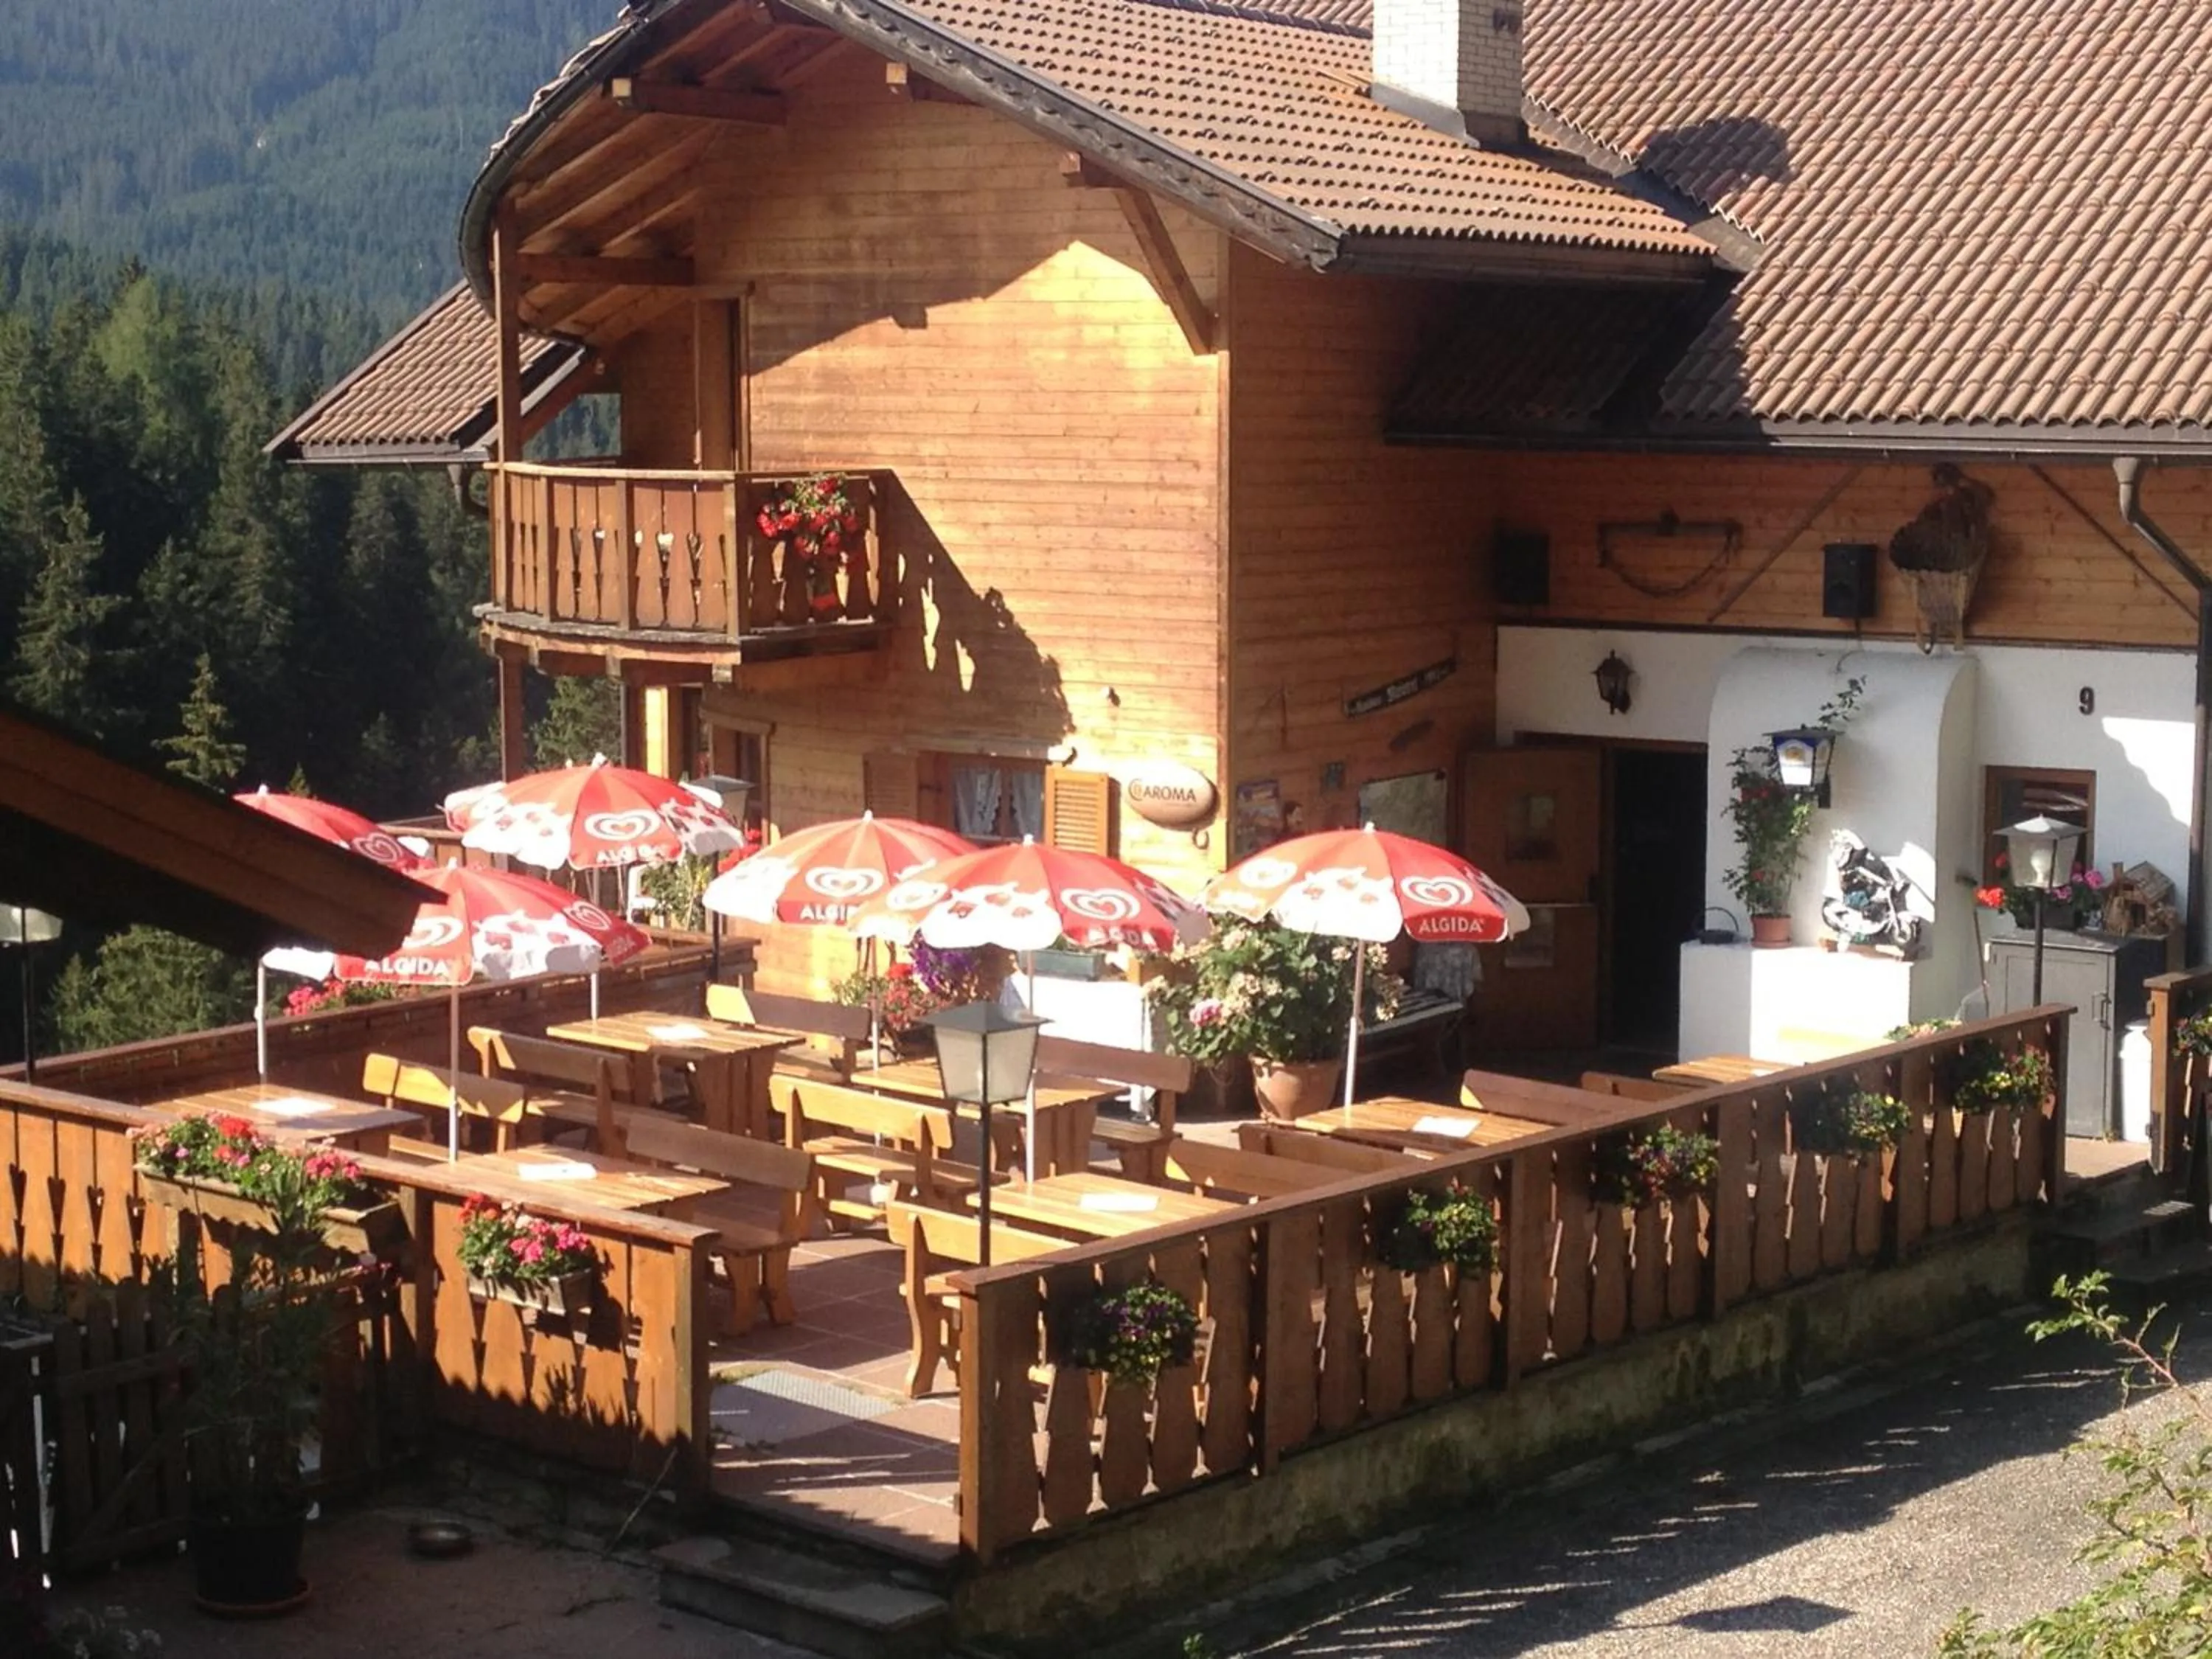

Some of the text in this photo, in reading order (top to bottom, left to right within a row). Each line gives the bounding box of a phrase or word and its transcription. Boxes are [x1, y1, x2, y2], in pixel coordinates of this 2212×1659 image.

[2079, 686, 2095, 715] 9
[799, 904, 860, 921] ALGI
[1419, 917, 1483, 933] ALGIDA
